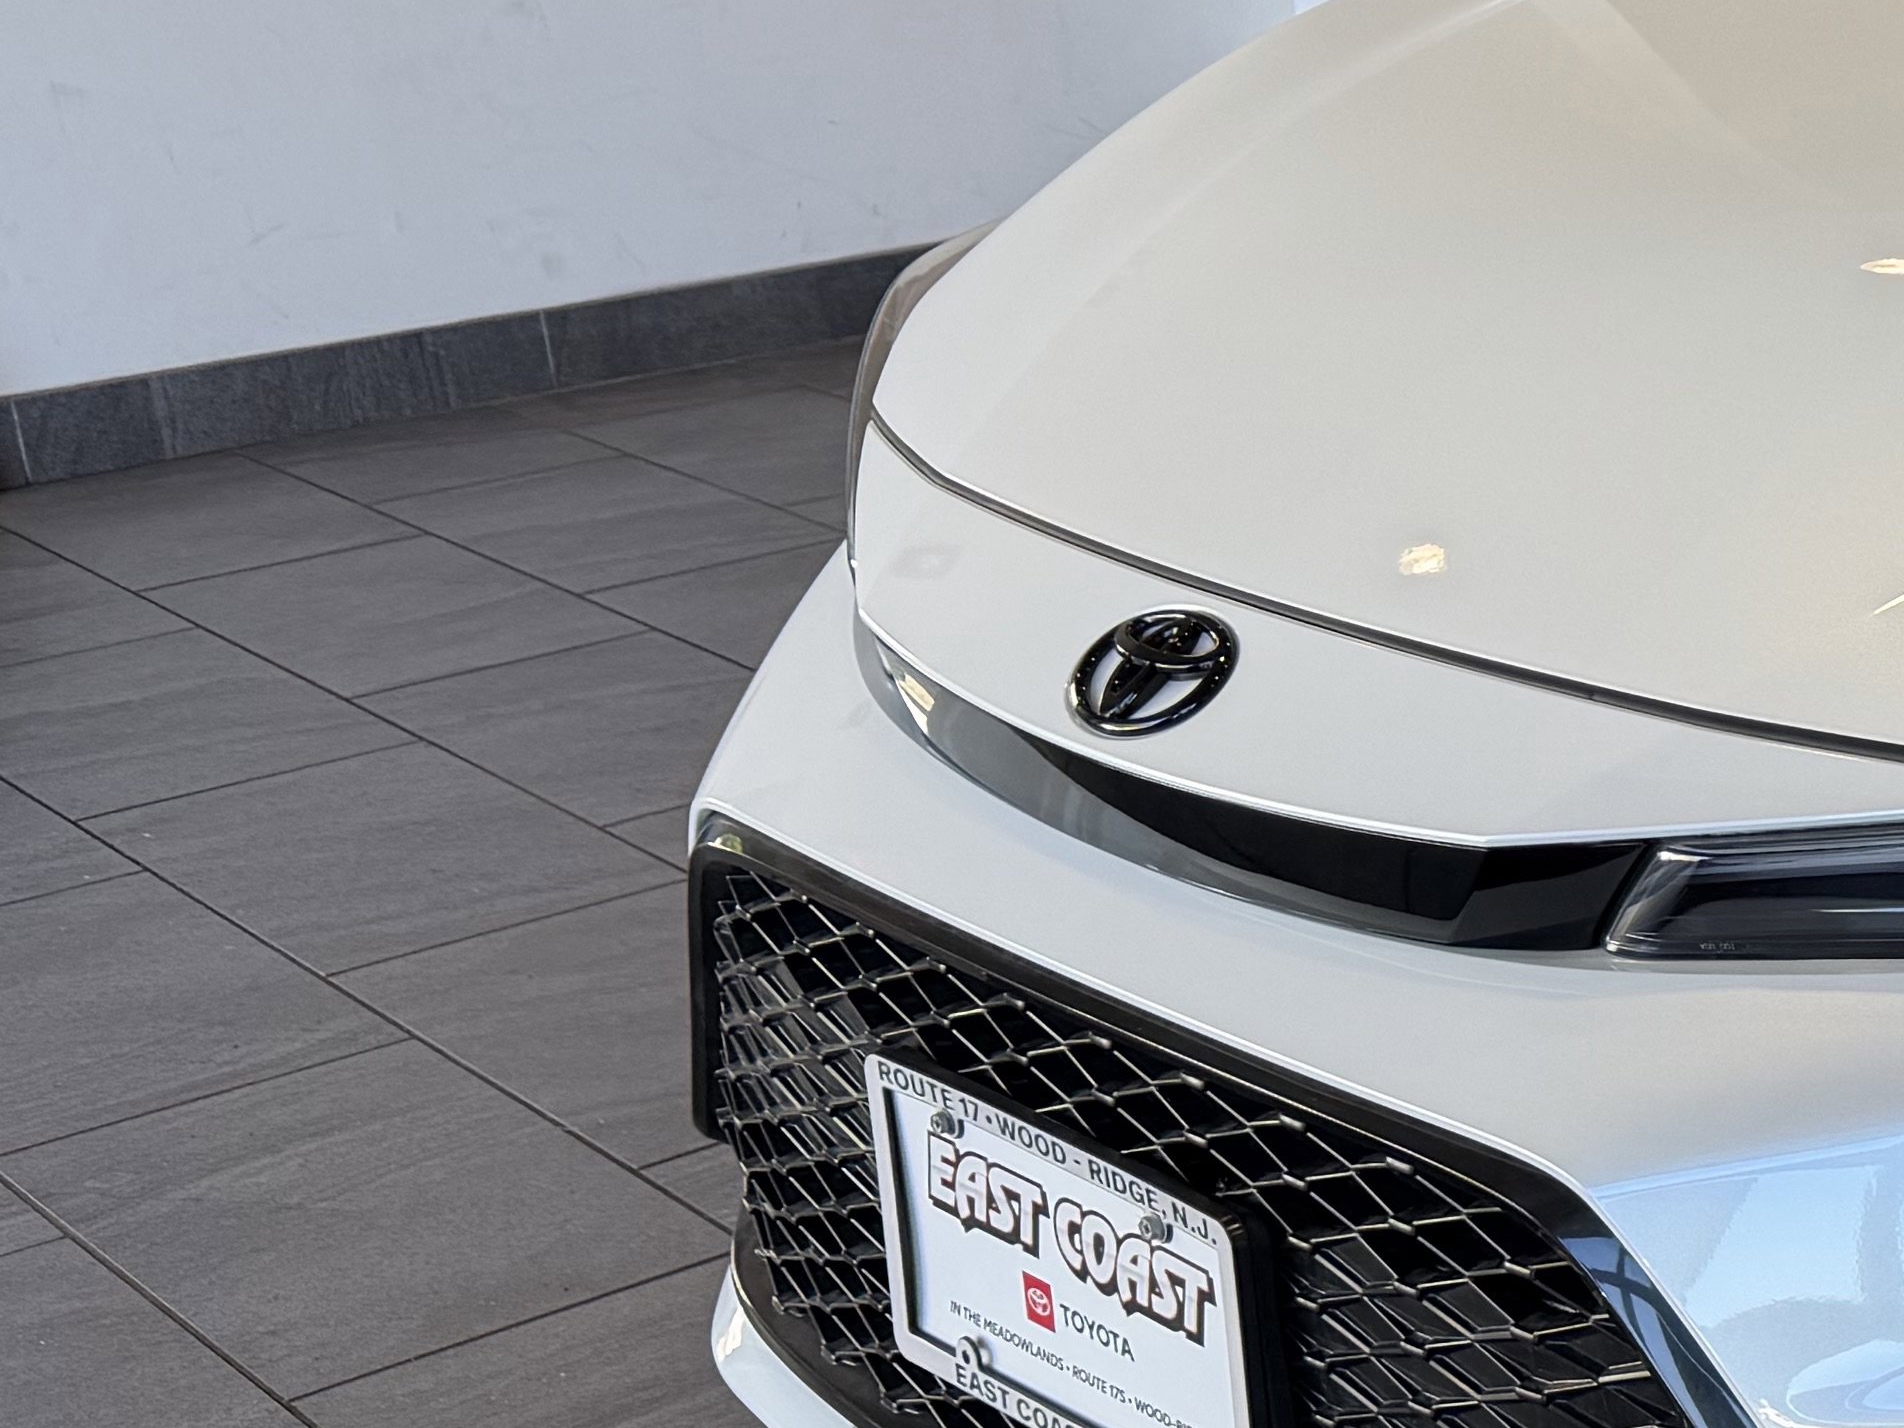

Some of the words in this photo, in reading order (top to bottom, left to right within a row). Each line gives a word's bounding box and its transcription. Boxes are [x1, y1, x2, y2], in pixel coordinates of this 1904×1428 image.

[878, 1061, 955, 1111] ROUTE
[959, 1097, 980, 1123] 17
[996, 1113, 1067, 1165] WOOD
[1088, 1159, 1167, 1219] RIDGE,
[1172, 1201, 1217, 1246] N.J.
[928, 1128, 1050, 1259] EAST
[1053, 1197, 1227, 1347] COAST
[950, 1300, 961, 1317] IN
[963, 1307, 982, 1328] THE
[984, 1317, 1064, 1371] MEADOWLANDS
[1072, 1365, 1108, 1394] ROUTE
[1109, 1384, 1126, 1404] 17S
[1059, 1303, 1135, 1362] TOYOTA
[955, 1363, 1010, 1409] EAST
